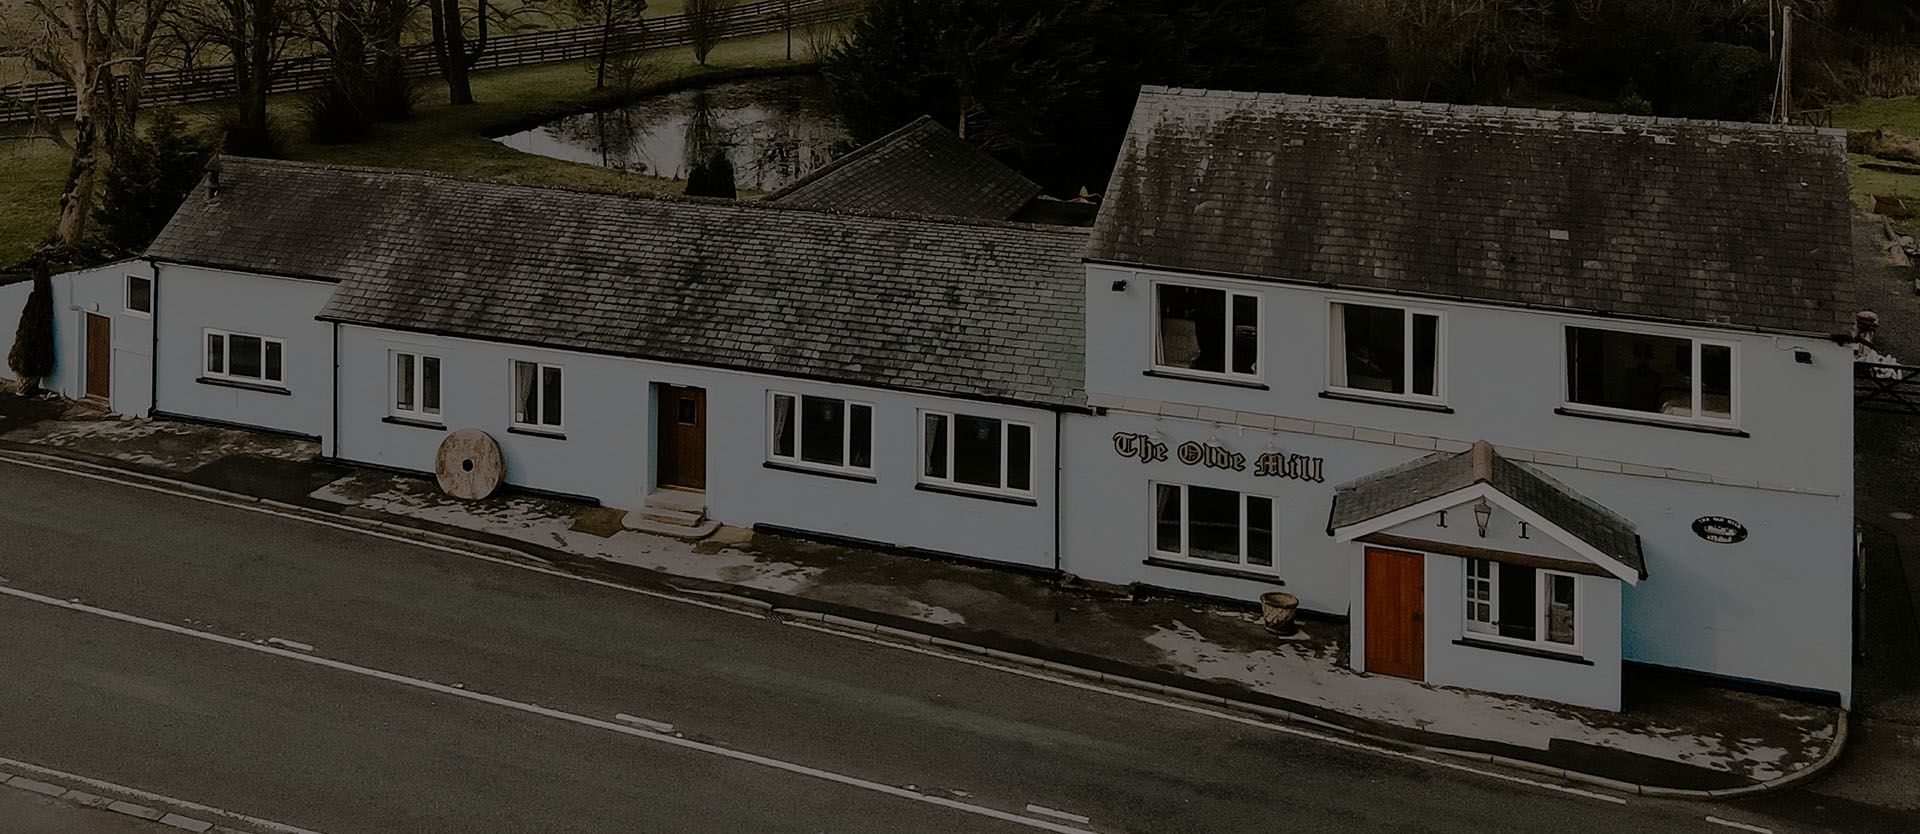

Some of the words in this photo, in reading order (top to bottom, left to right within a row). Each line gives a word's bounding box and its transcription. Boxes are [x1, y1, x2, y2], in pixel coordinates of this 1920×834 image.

[1112, 432, 1168, 463] The
[1177, 441, 1246, 472] Olde
[1254, 452, 1324, 483] Mill
